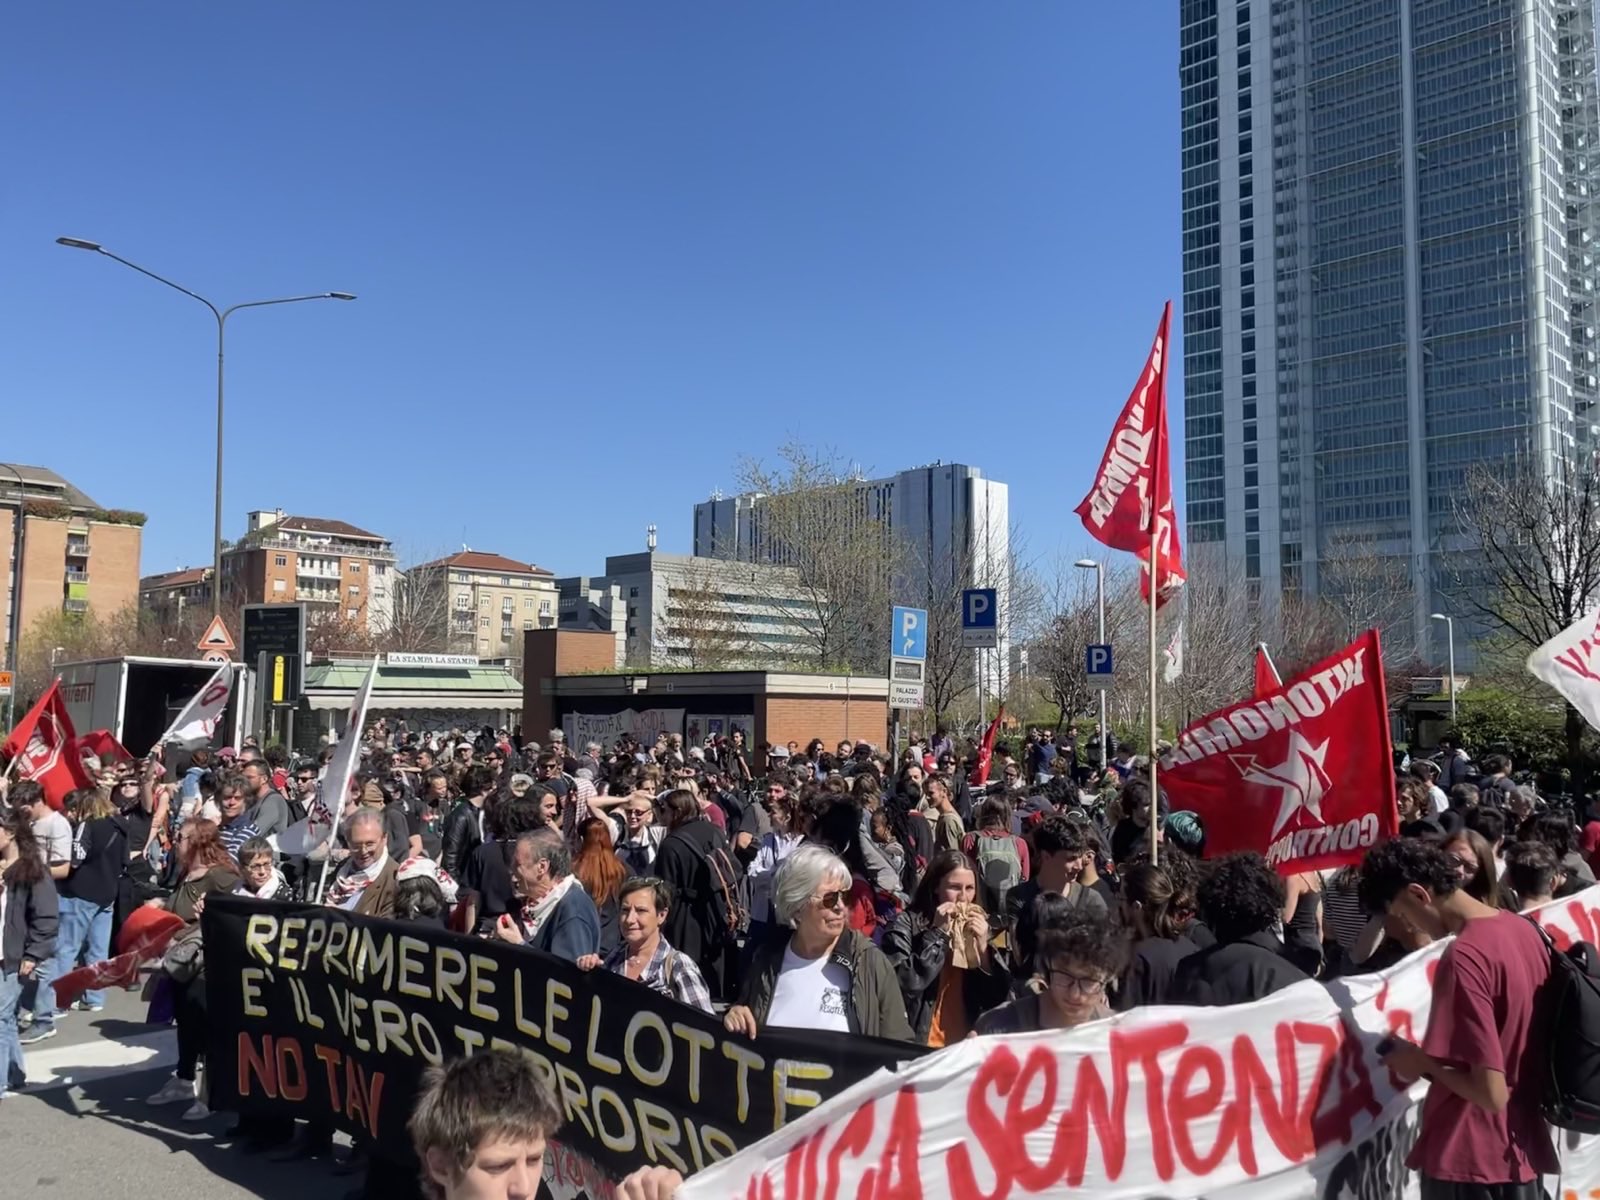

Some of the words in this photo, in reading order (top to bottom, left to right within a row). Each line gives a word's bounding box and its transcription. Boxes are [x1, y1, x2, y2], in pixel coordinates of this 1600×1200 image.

[969, 594, 989, 623] P
[903, 612, 917, 637] P
[389, 655, 400, 663] LA
[402, 655, 434, 664] STAMPA
[435, 656, 446, 664] LA
[447, 657, 477, 665] STAMPA
[1091, 648, 1108, 672] P
[891, 696, 897, 704] DI
[896, 687, 918, 696] PALAZZO
[246, 914, 500, 1022] REPRIMERE
[514, 967, 573, 1054] LE
[586, 994, 834, 1132] LOTTE
[288, 976, 325, 1030] IL
[327, 983, 443, 1065] VERO
[238, 1031, 308, 1101] NO
[315, 1042, 385, 1140] TAV
